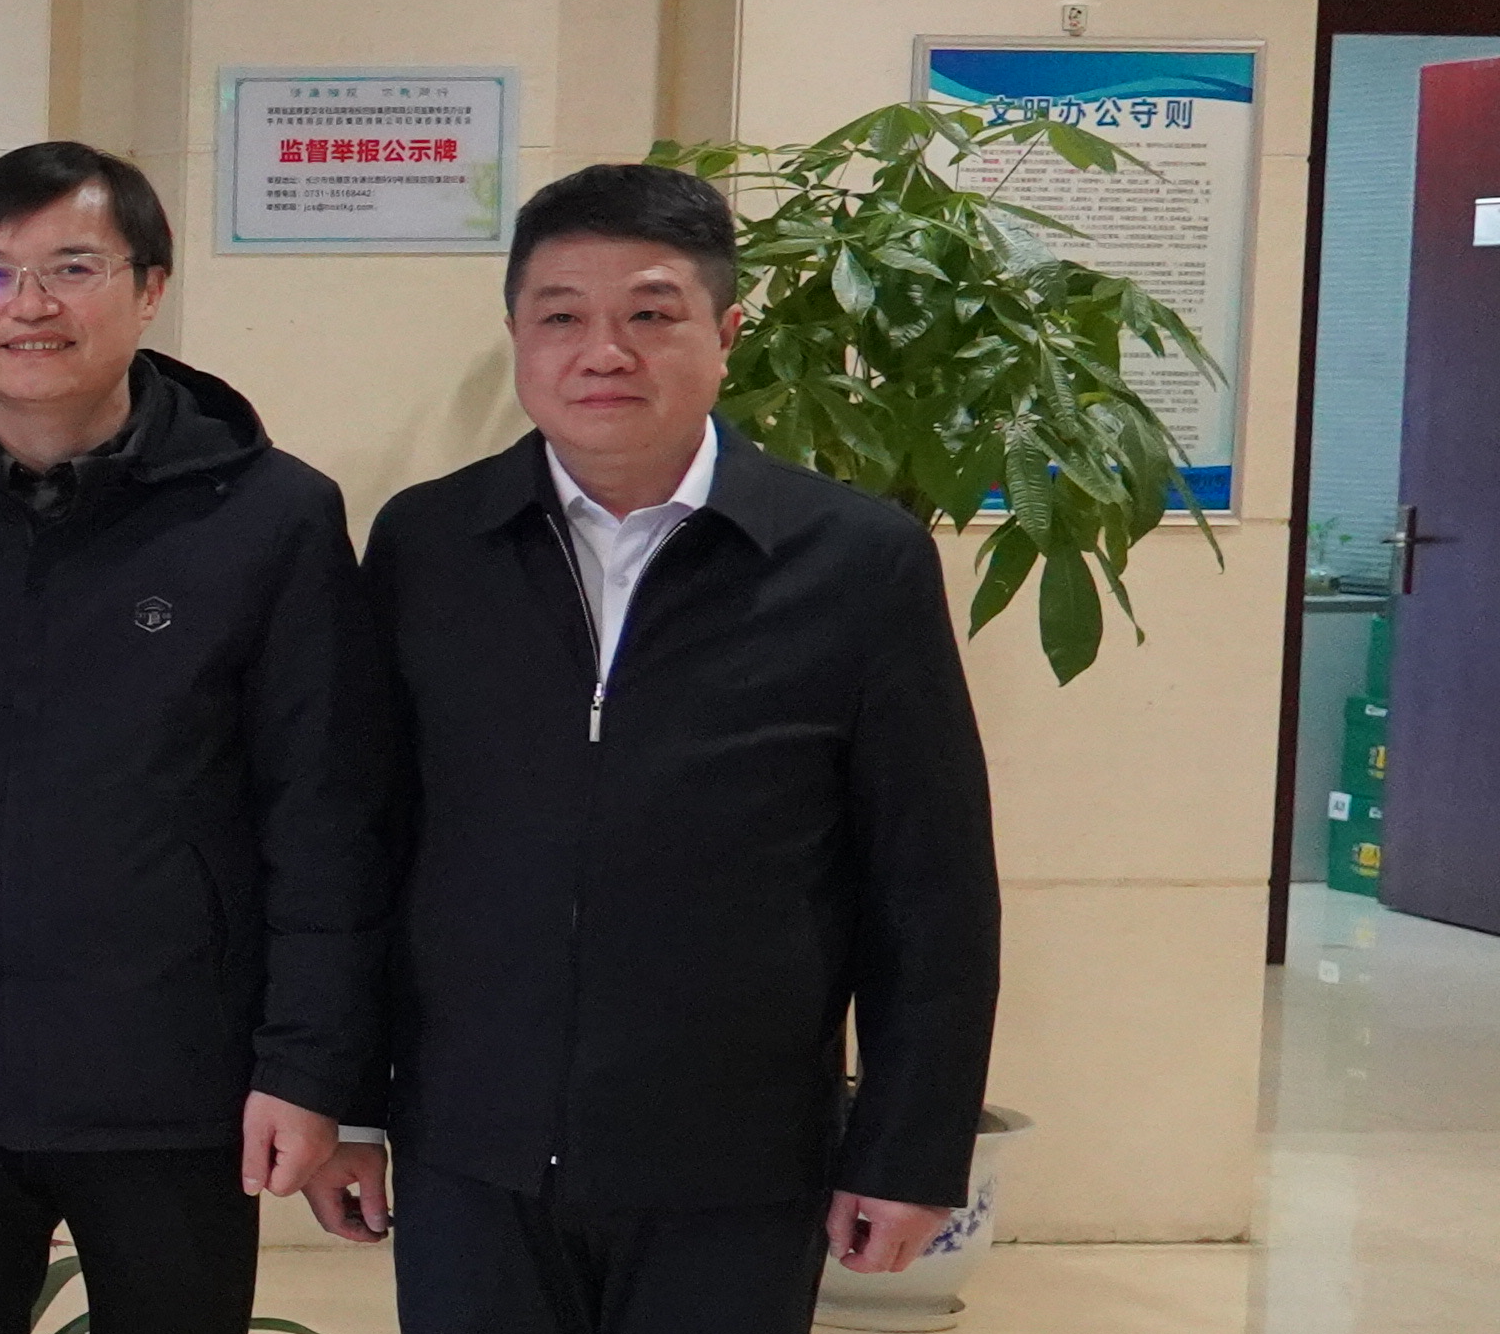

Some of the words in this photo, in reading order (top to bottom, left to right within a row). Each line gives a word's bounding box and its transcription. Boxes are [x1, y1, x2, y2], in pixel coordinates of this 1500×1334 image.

[984, 95, 1194, 130] 文明办公守则
[279, 139, 459, 163] 监督举报公示牌
